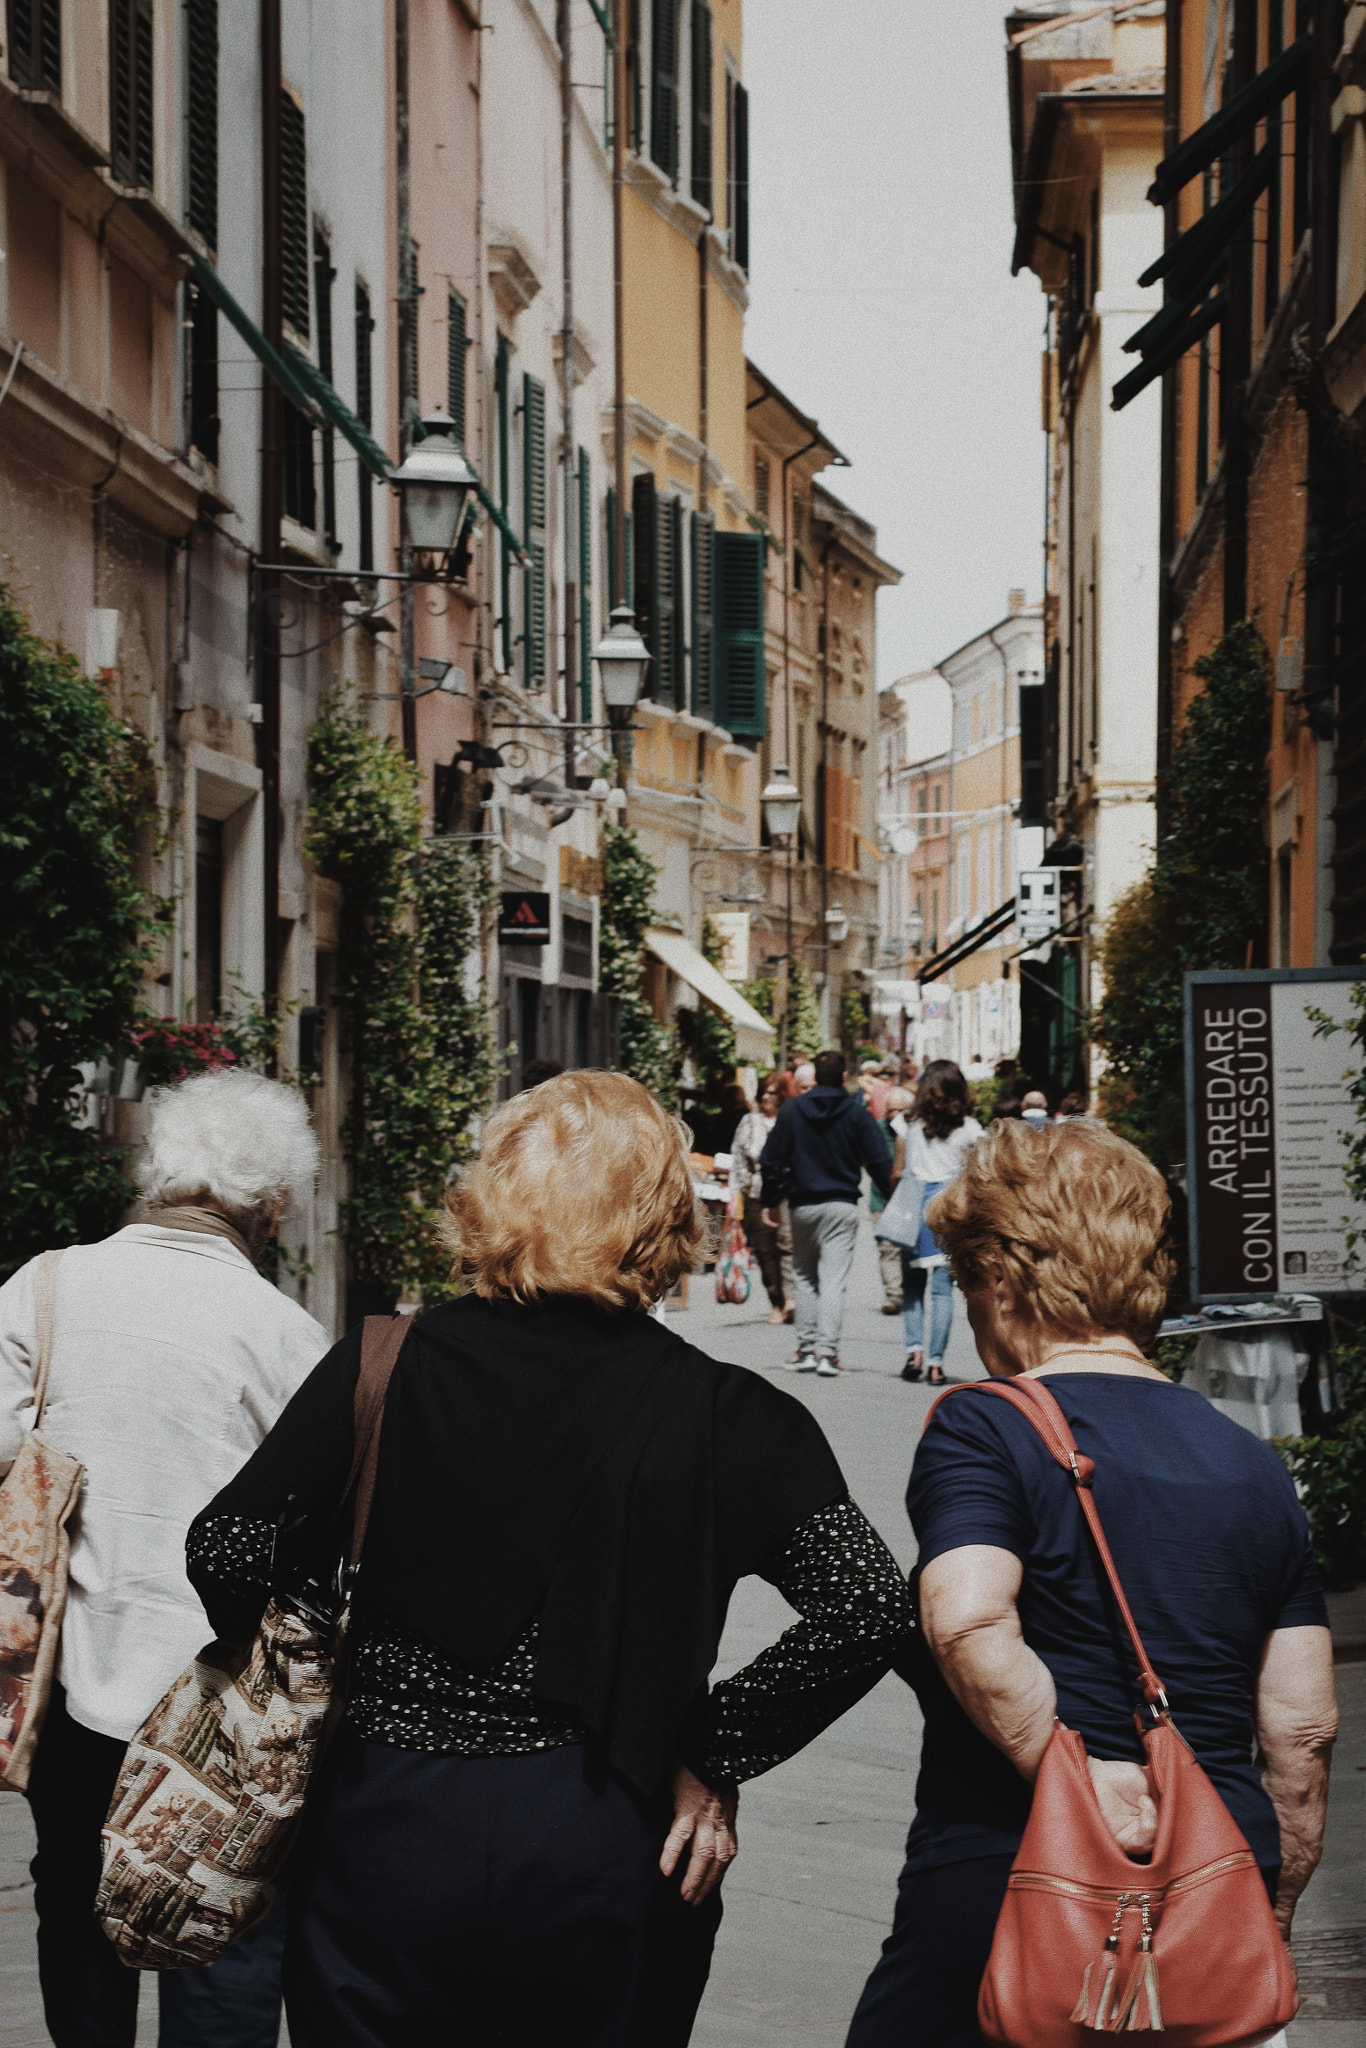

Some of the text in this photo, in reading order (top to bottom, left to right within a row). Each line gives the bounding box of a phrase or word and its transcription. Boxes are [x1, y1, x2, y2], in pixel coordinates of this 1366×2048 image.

[1205, 1008, 1239, 1193] ARREDARE
[1238, 1007, 1273, 1282] CON IL TESSUTO
